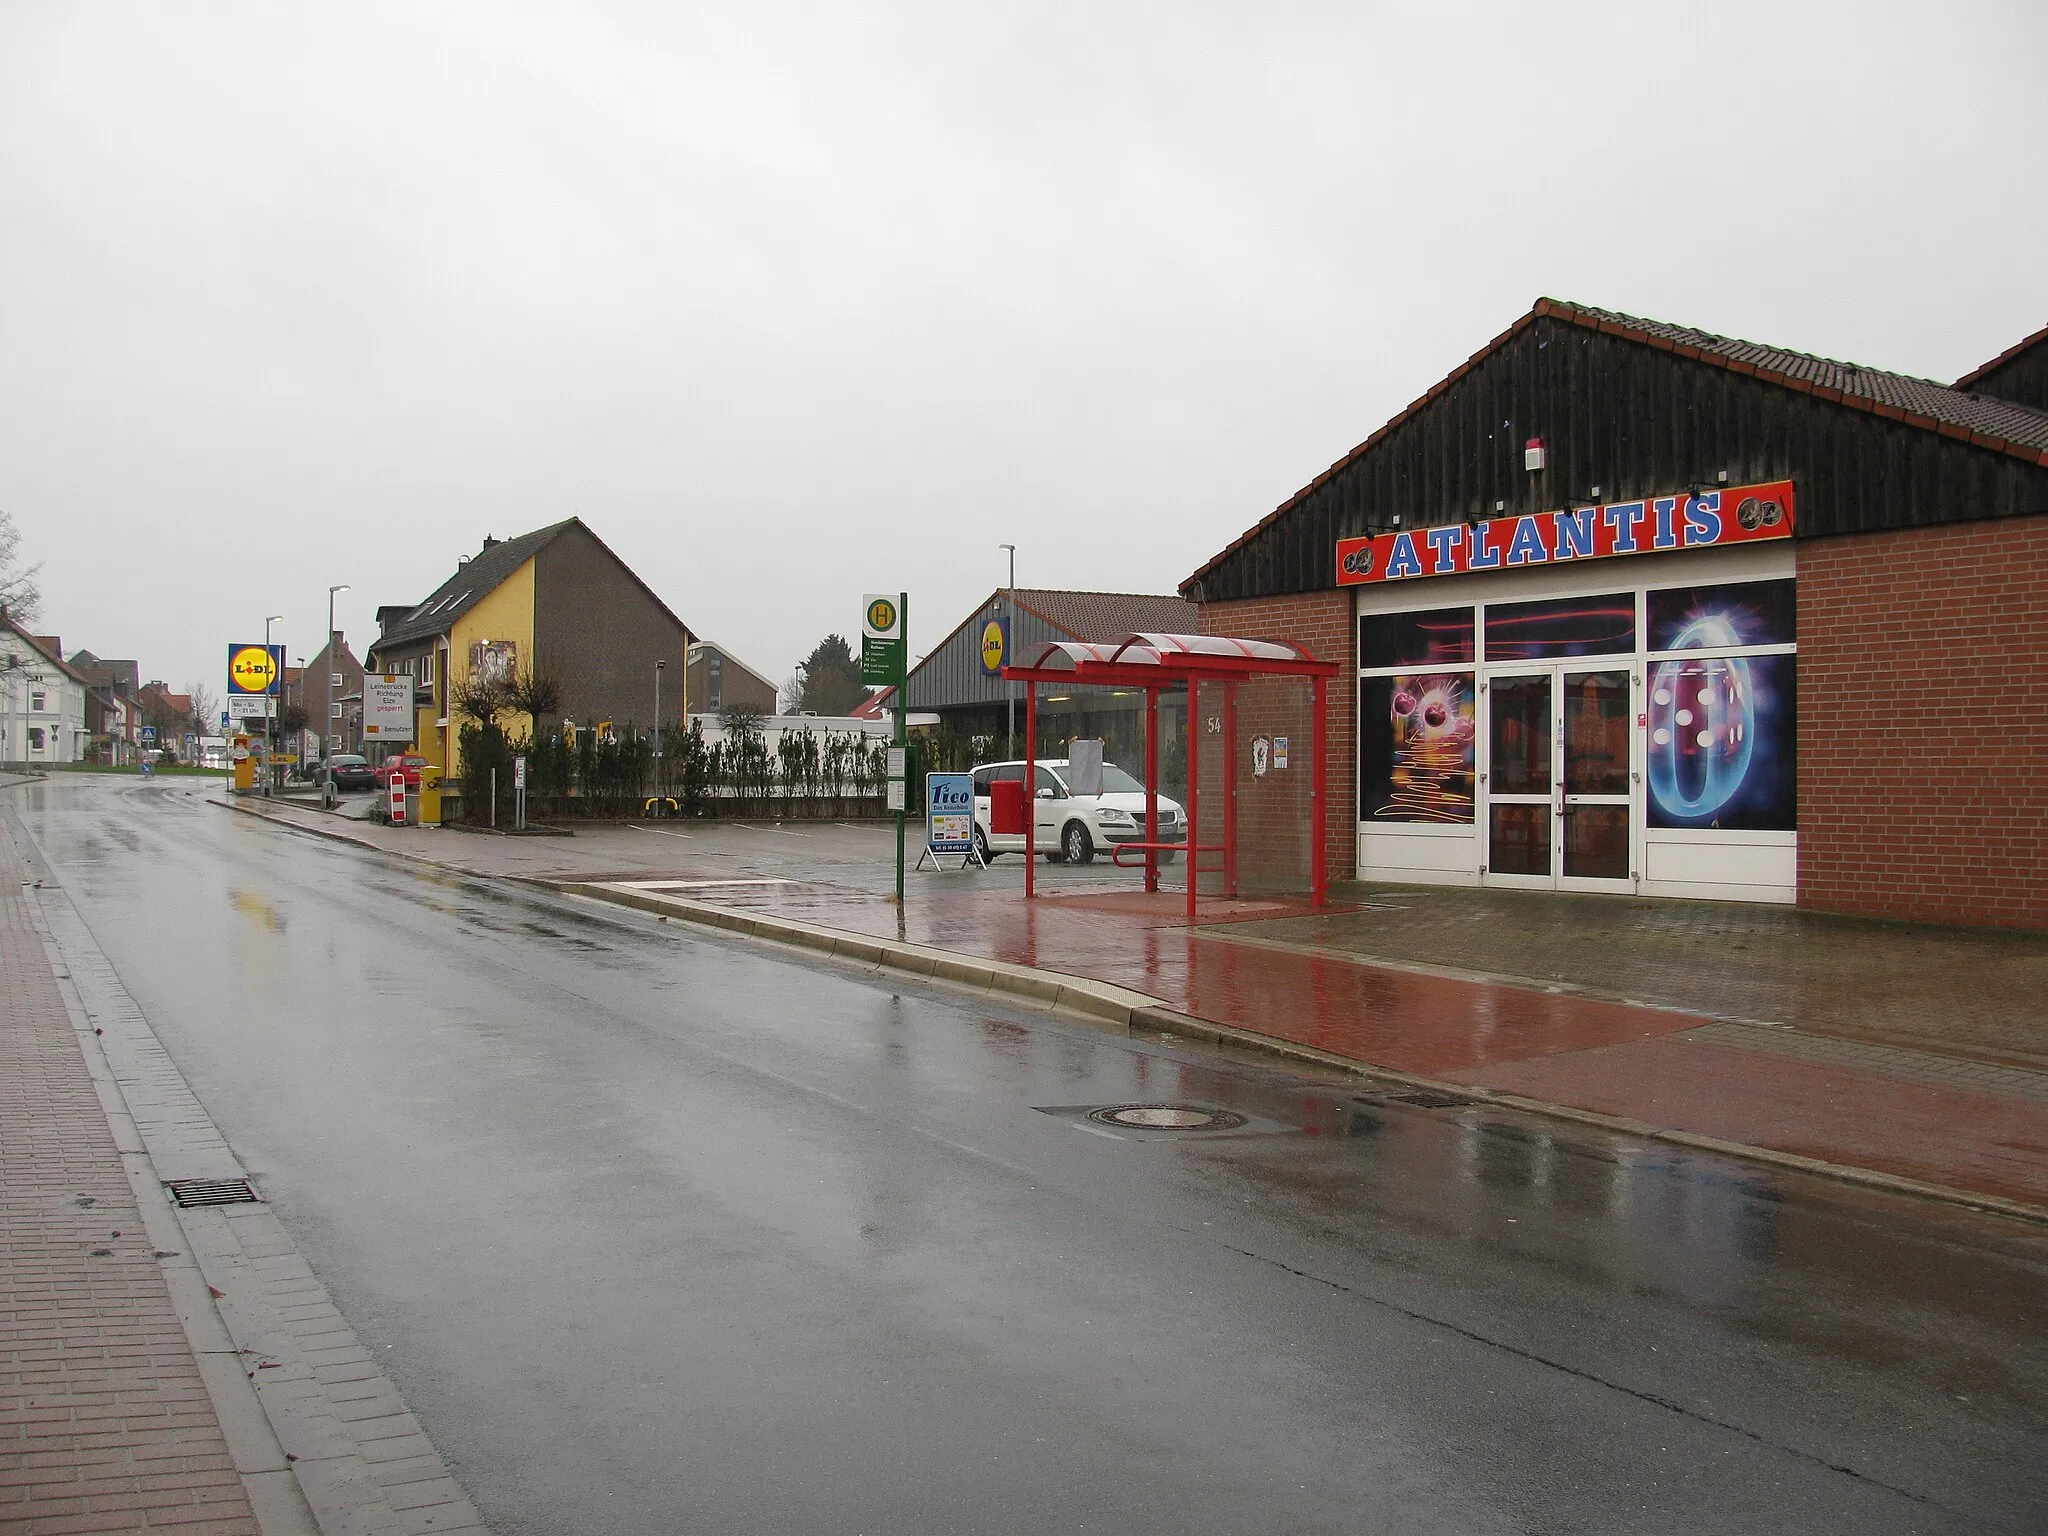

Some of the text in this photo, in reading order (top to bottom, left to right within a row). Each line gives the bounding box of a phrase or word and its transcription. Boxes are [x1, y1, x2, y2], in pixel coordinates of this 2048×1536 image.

[1385, 492, 1722, 580] ATLANTIS
[875, 606, 888, 625] H
[376, 690, 404, 698] Richtung
[1208, 716, 1221, 733] 54
[932, 782, 969, 804] Tico
